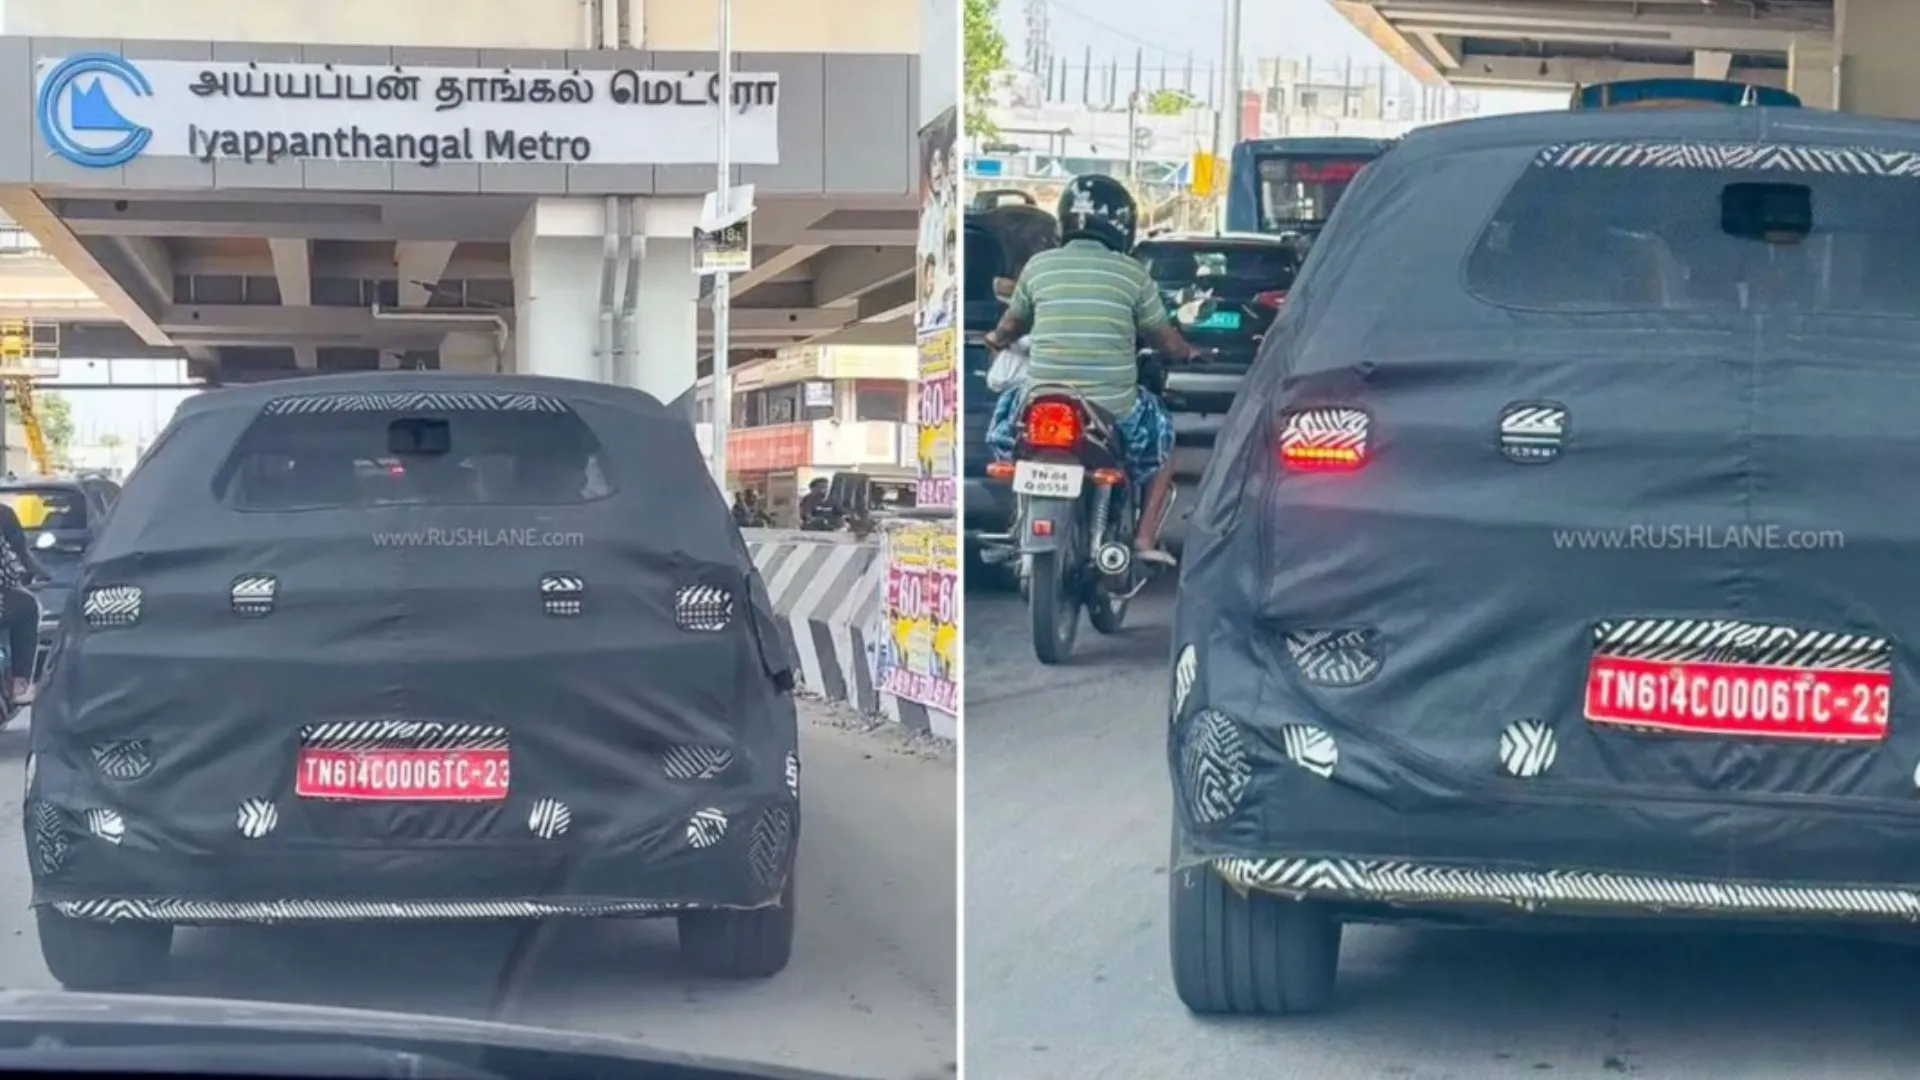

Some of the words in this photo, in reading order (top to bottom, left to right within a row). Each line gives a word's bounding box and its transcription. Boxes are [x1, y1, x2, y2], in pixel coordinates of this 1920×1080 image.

[188, 62, 420, 101] அய்யப்பன்
[435, 67, 594, 112] தாங்கல்
[188, 124, 471, 168] Iyappanthangal
[485, 129, 592, 161] Metro
[1595, 667, 1890, 724] TN614C0006TC-23
[305, 756, 510, 790] TN614C0006TC-23
